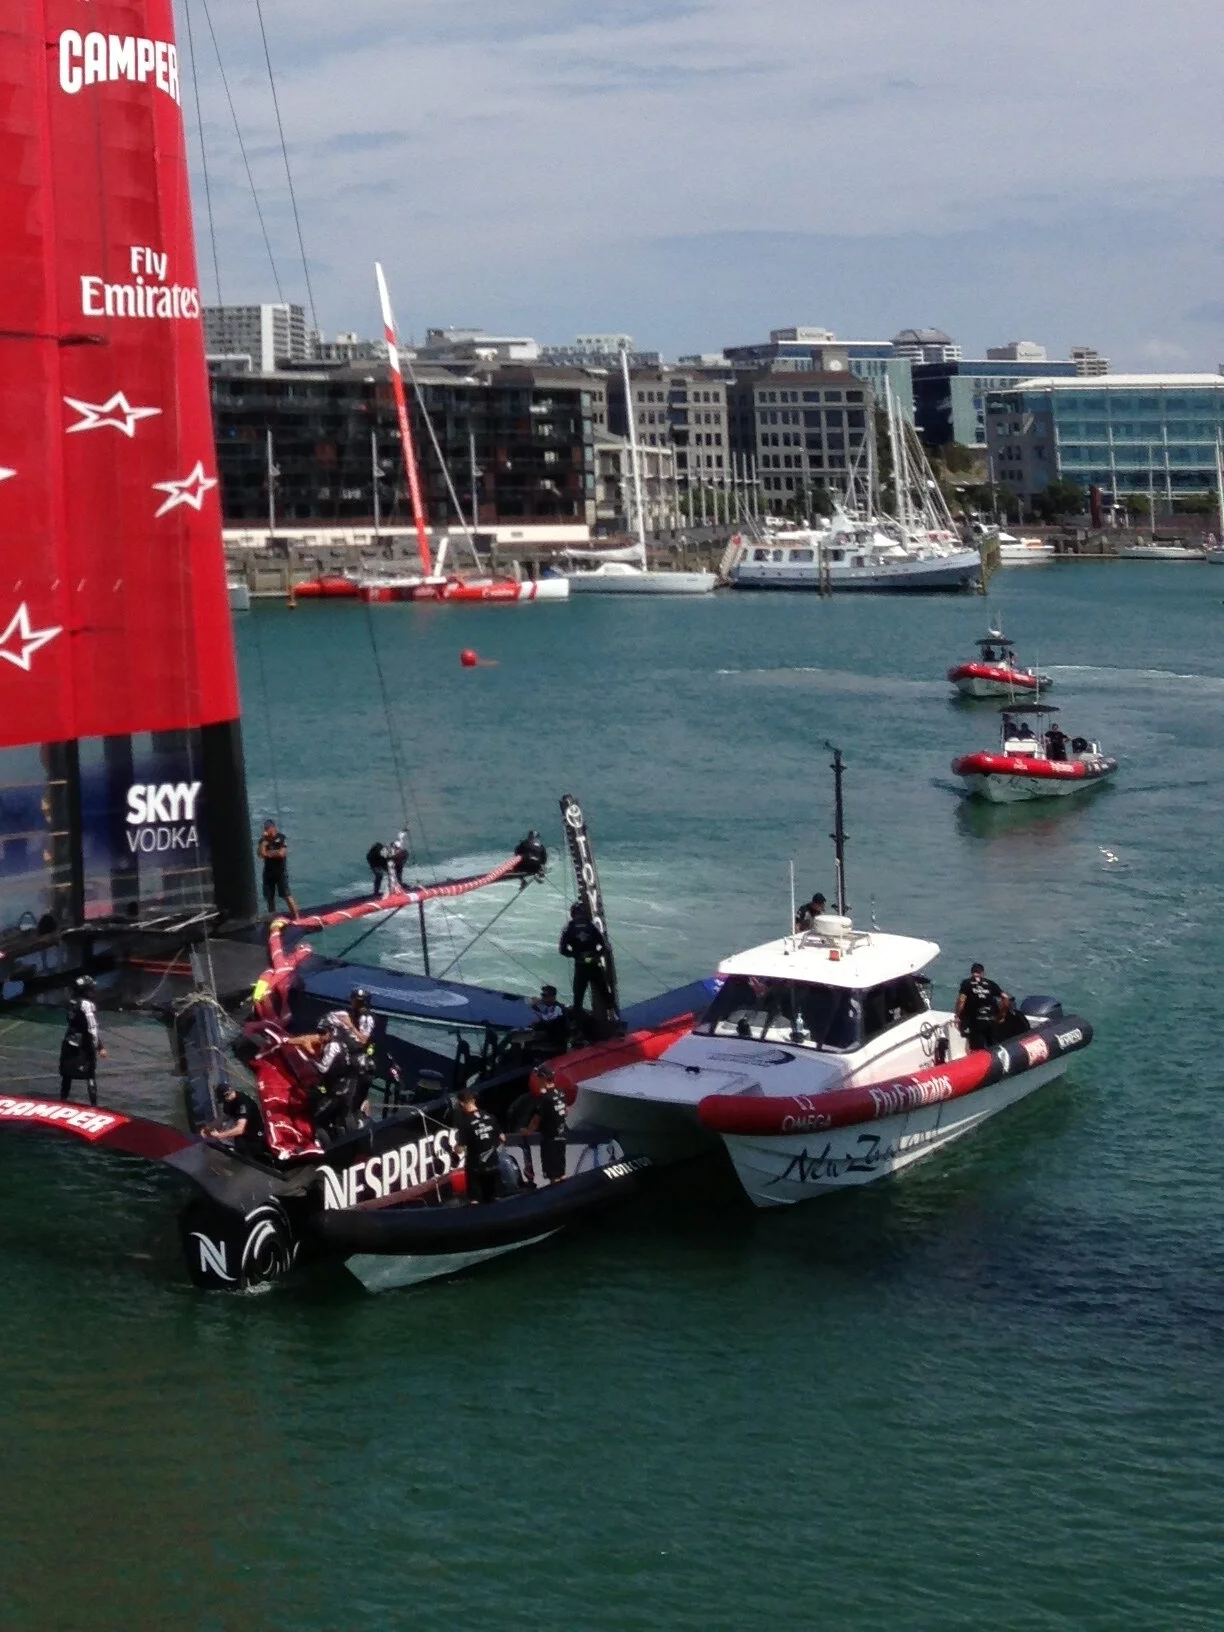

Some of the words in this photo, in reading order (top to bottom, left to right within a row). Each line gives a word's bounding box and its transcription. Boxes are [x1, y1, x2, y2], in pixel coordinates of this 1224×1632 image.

[59, 29, 181, 106] CAMPER
[129, 245, 168, 281] Fly
[80, 274, 199, 320] Emirates
[126, 780, 202, 825] SKYY
[125, 825, 200, 854] VODKA
[782, 1114, 833, 1132] OMEGA
